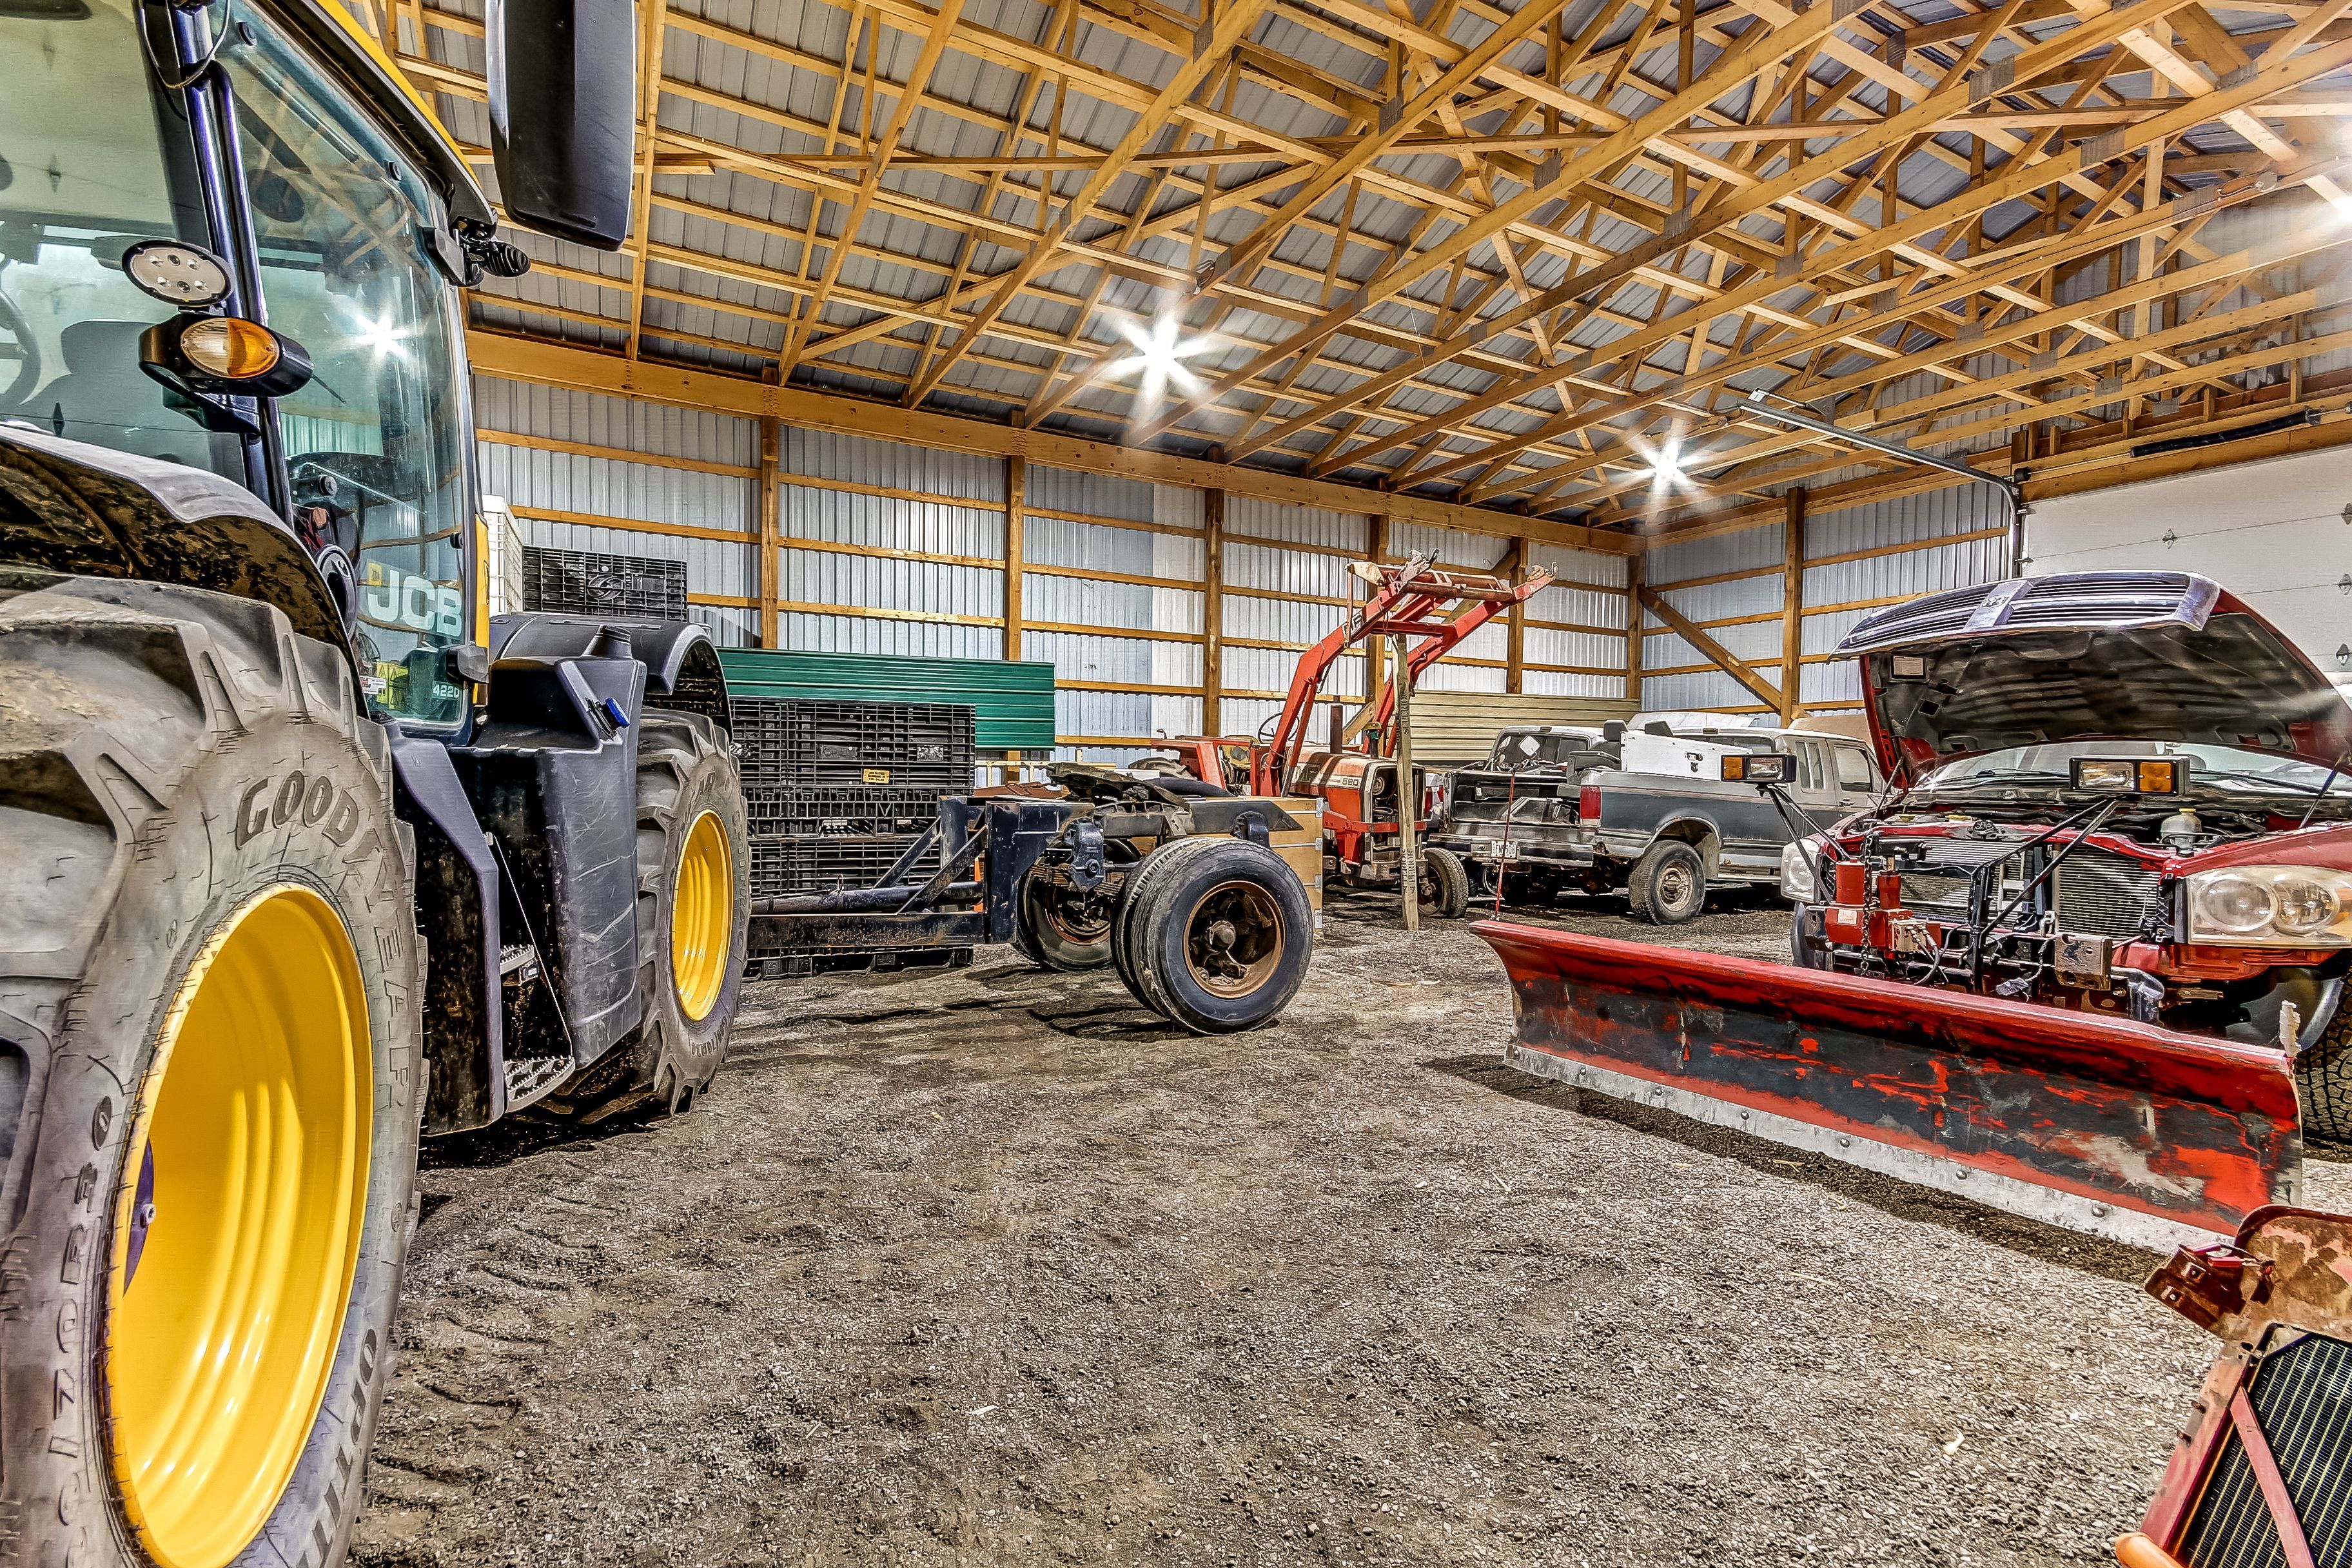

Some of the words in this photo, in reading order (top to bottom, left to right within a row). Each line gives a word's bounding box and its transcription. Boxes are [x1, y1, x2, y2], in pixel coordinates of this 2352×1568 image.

[368, 569, 462, 637] JCB
[433, 684, 460, 698] 4220
[296, 1328, 377, 1568] OPTIT
